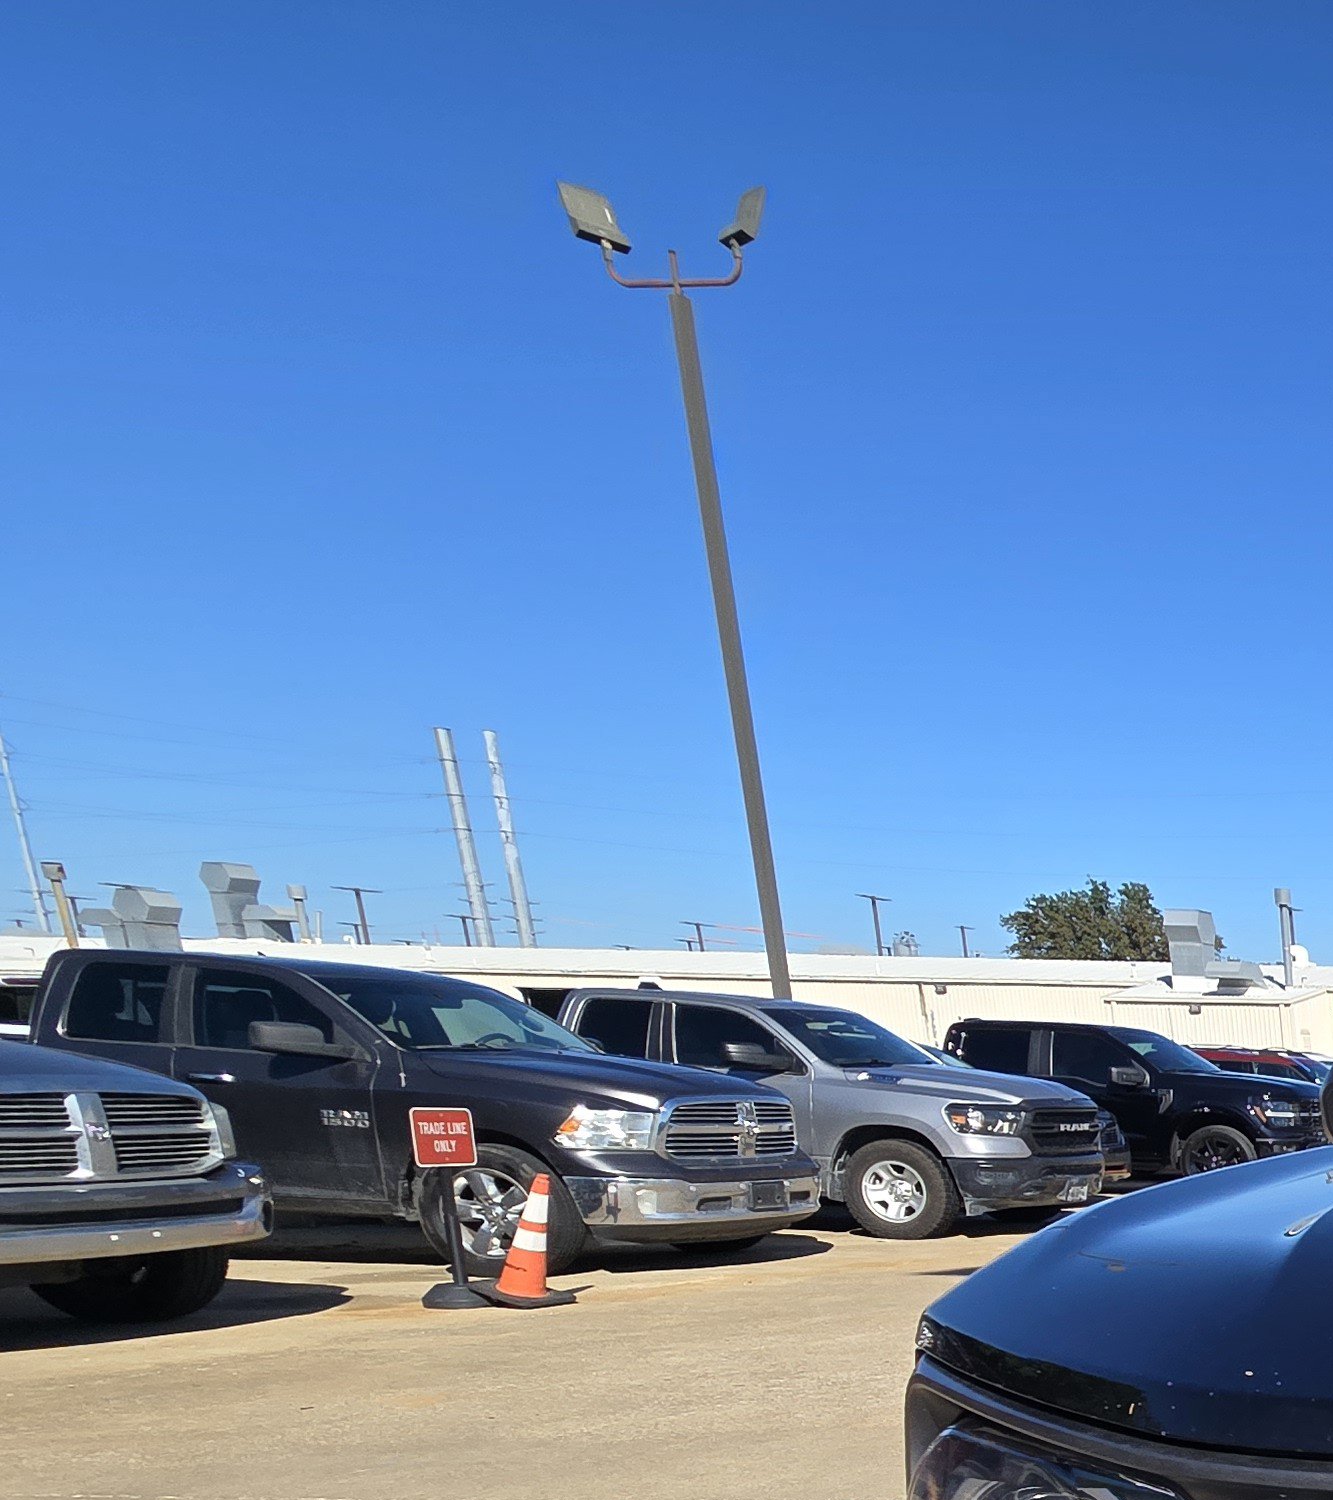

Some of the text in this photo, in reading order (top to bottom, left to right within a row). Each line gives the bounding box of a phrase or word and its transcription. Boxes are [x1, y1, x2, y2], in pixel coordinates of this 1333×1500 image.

[417, 1121, 468, 1135] TRADE LINE
[1060, 1123, 1090, 1132] RAM
[433, 1139, 457, 1153] ONLY
